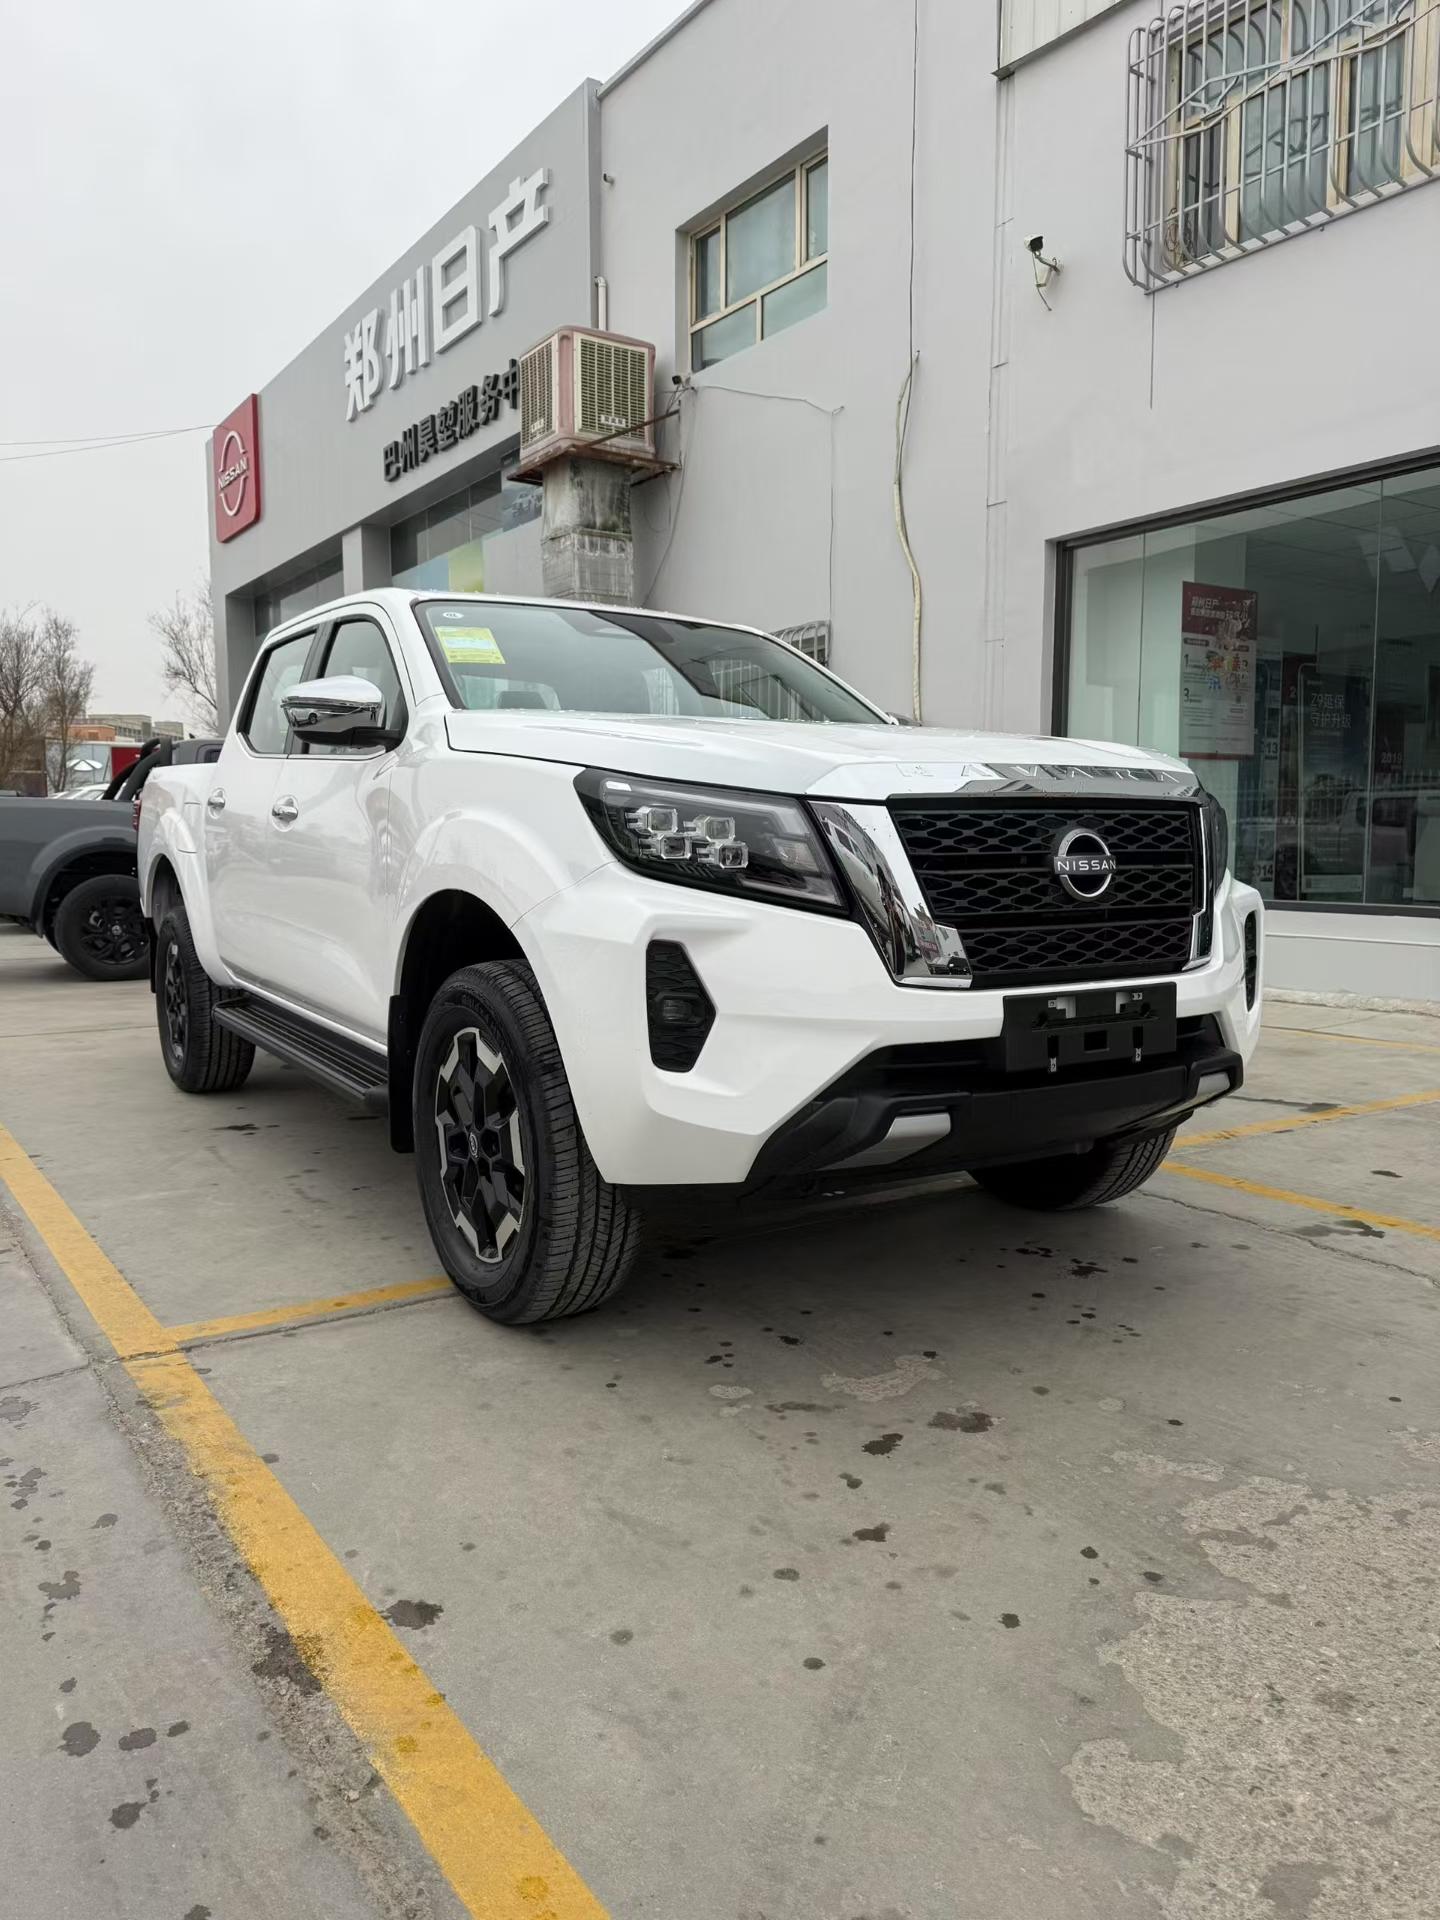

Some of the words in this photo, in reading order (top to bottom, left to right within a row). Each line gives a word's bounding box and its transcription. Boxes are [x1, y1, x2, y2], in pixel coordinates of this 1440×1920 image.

[344, 167, 549, 421] 郑州日产
[217, 457, 248, 490] NISSAN
[1057, 858, 1117, 872] NISSAN
